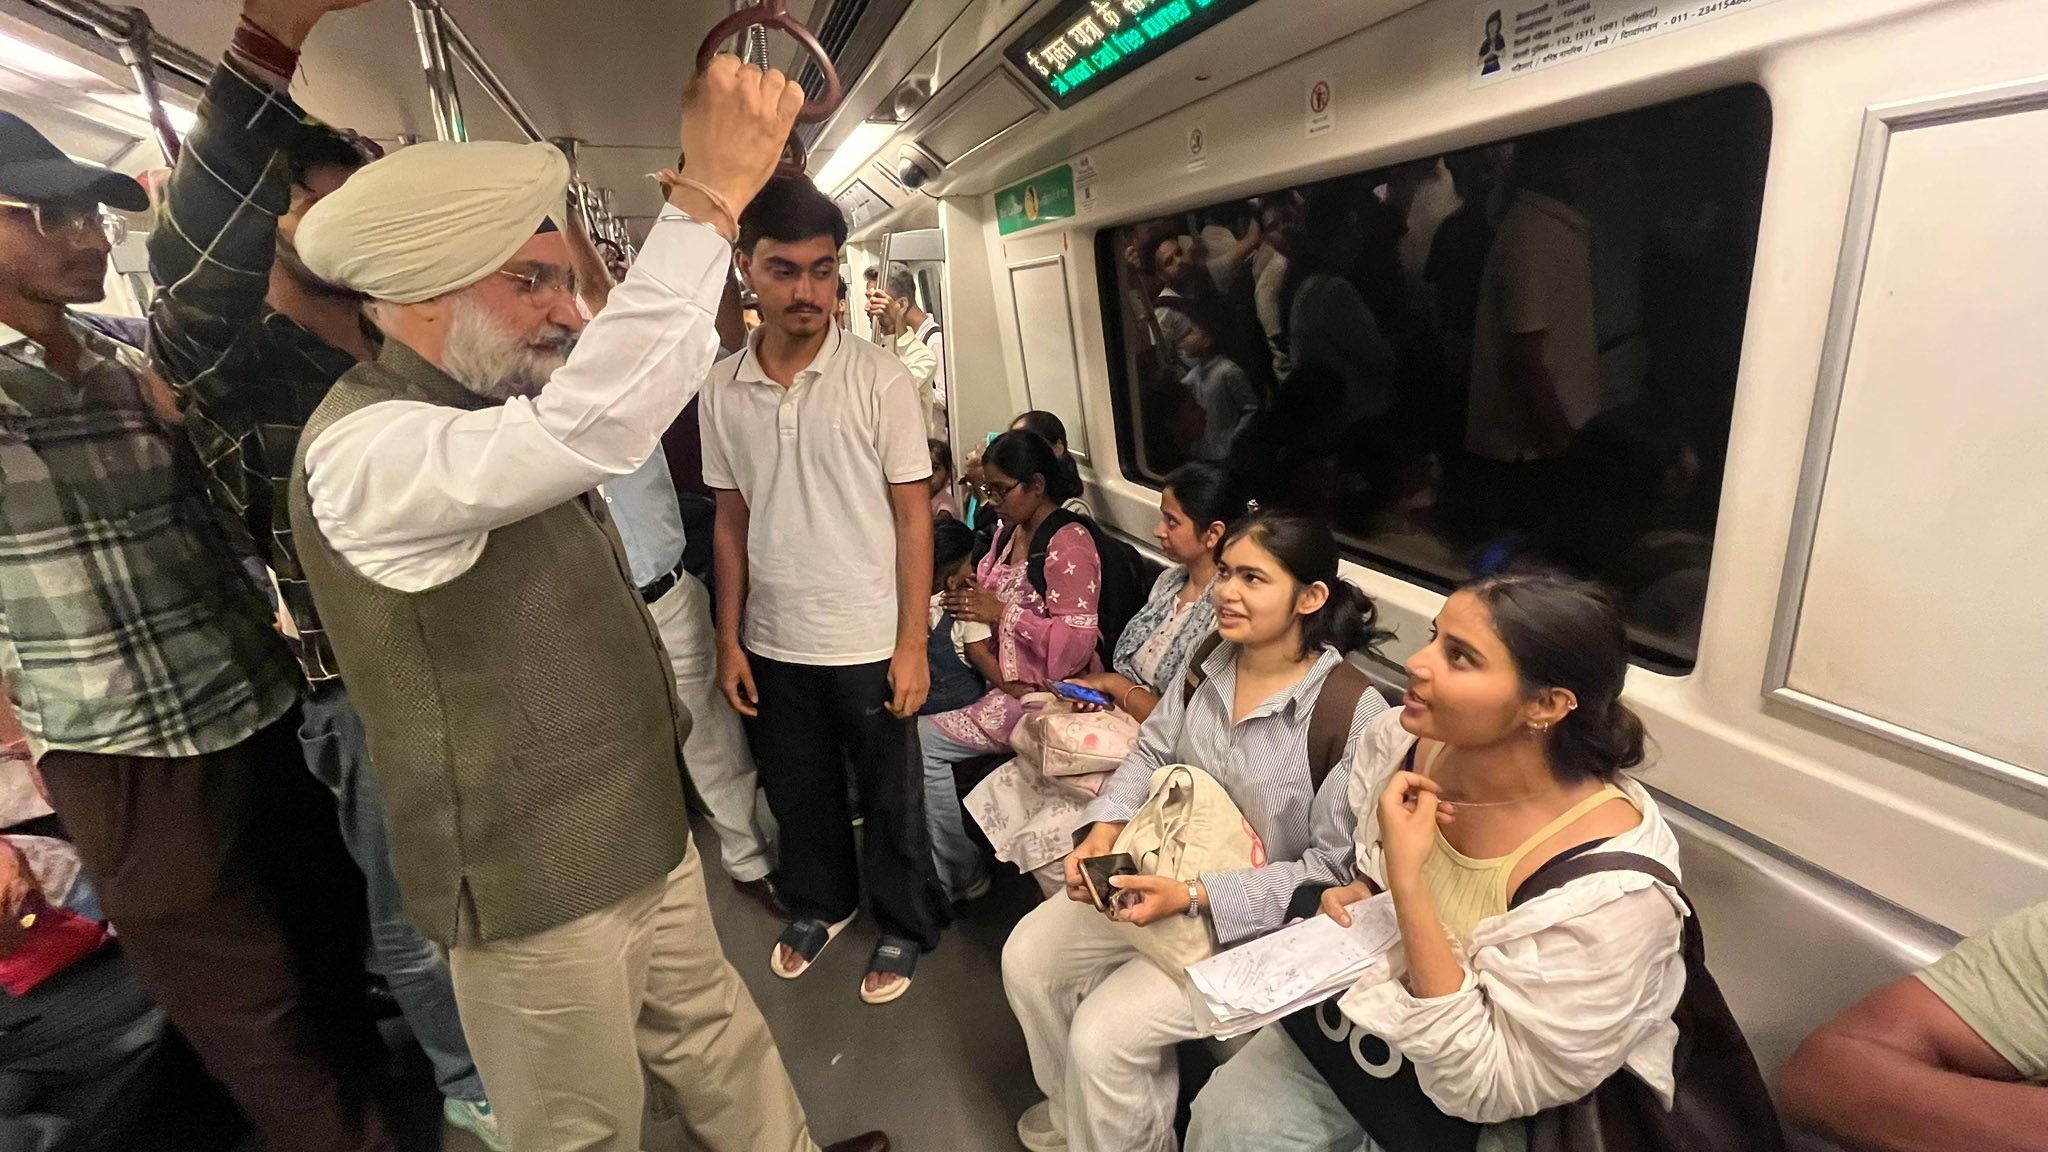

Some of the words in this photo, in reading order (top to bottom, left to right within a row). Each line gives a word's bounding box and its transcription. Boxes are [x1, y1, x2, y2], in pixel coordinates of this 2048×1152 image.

[1040, 37, 1076, 71] मुक्त
[1067, 16, 1104, 46] यात्रा
[1091, 0, 1120, 28] के
[1064, 58, 1096, 88] smart
[1091, 40, 1120, 71] card
[1111, 29, 1144, 54] free
[1136, 0, 1191, 39] journey
[1670, 12, 1688, 25] 011
